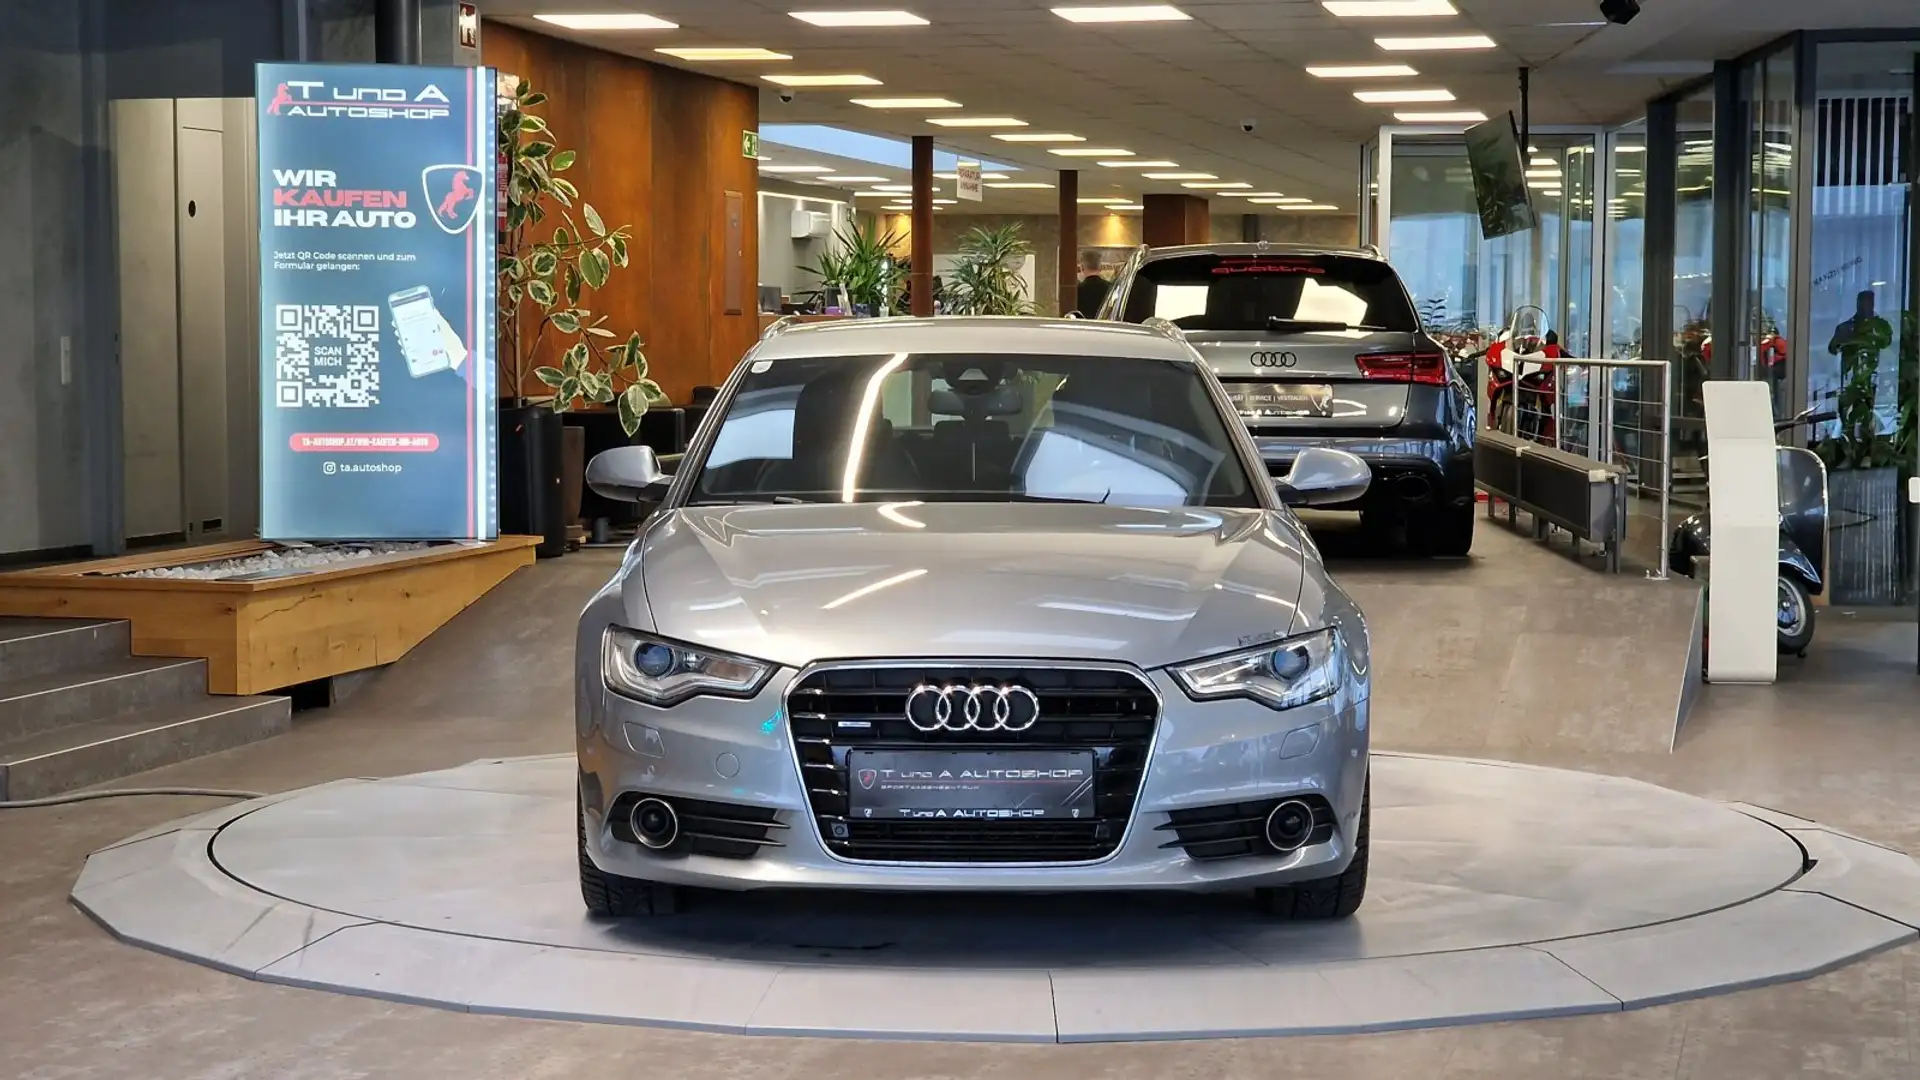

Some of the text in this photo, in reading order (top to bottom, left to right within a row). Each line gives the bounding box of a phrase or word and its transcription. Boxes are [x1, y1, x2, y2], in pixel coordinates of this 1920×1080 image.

[287, 80, 324, 99] T
[413, 84, 450, 102] A
[288, 105, 450, 119] AUTOSHOP
[272, 169, 337, 187] WIR
[273, 188, 407, 208] KAUFEN
[273, 209, 417, 228] IHR AUTO
[273, 251, 296, 260] Jetzt
[297, 252, 311, 260] QR
[313, 252, 335, 260] Code
[377, 253, 394, 261] und
[274, 262, 360, 272] Formular gelangen:
[1211, 265, 1326, 274] quattro
[314, 346, 342, 355] SCAN
[314, 356, 342, 366] MICH
[339, 463, 402, 474] ta.autoshop
[880, 769, 896, 778] T
[938, 770, 953, 778] A
[960, 769, 1084, 778] AUTOSHOP
[899, 808, 911, 817] T
[935, 809, 947, 817] A
[953, 809, 1045, 818] AUTOSHOP
